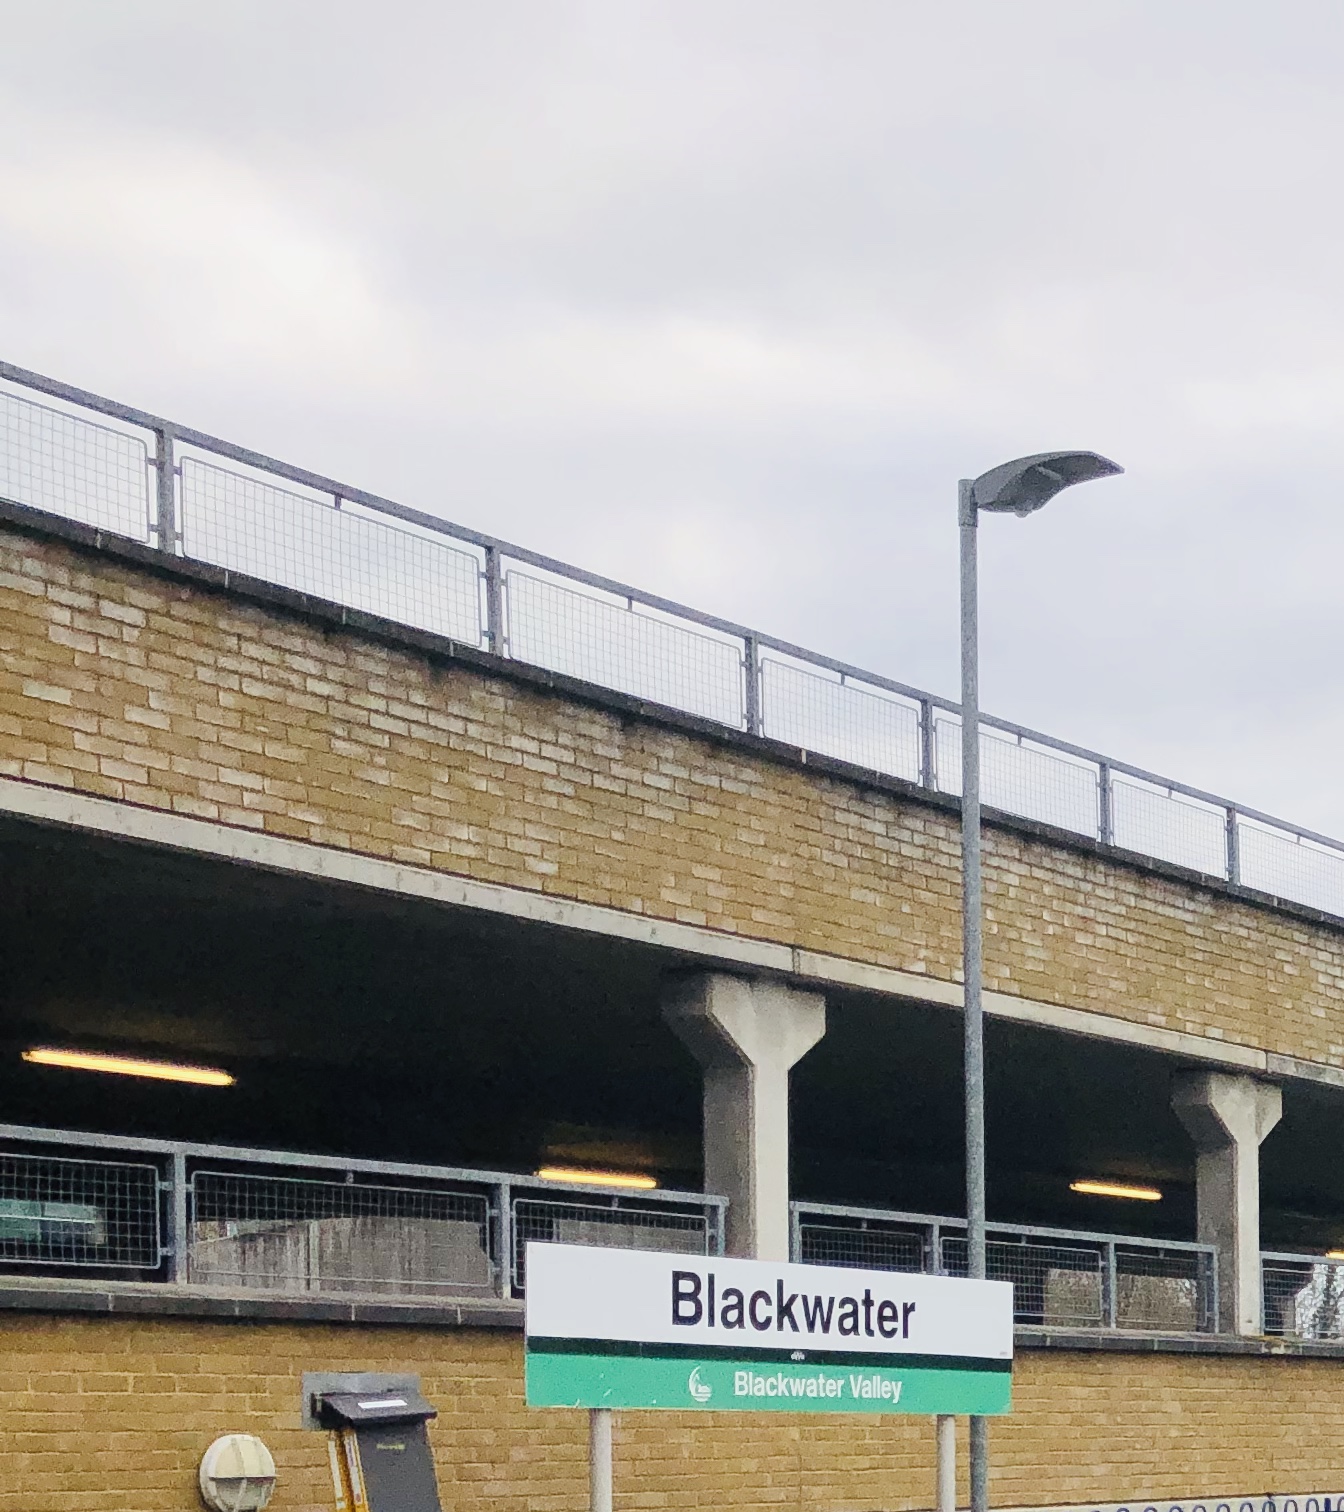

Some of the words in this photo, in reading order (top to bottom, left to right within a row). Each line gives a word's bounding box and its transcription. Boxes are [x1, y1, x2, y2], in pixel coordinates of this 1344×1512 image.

[671, 1269, 916, 1340] Blackwater
[733, 1370, 844, 1399] Blackwater
[849, 1374, 903, 1404] Valley
